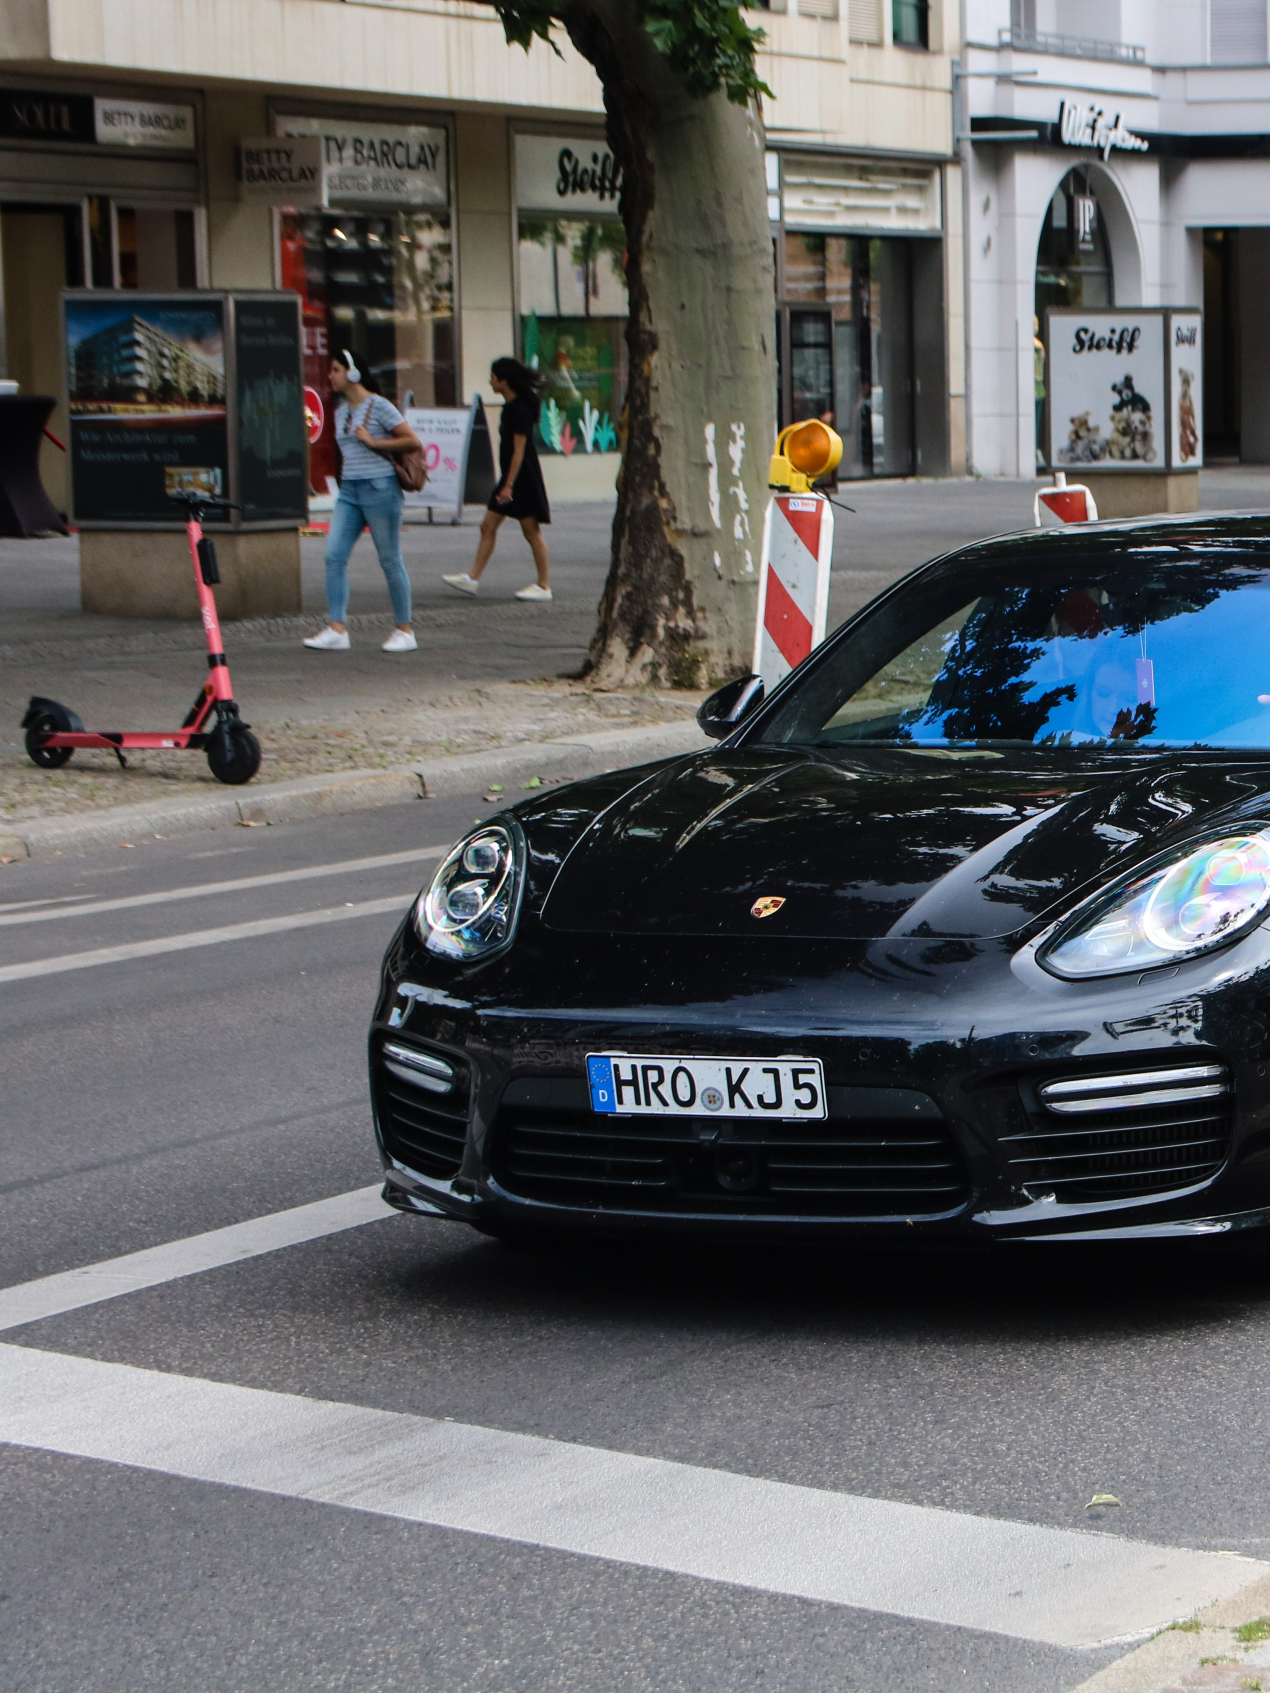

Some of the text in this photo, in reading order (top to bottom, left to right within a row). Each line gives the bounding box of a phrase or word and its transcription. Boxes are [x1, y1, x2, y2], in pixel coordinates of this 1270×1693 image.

[102, 109, 187, 132] BETTY BARCLAY
[245, 148, 294, 166] BETTY
[353, 138, 439, 171] BARCLAY
[246, 165, 318, 184] BARCLAY
[557, 146, 622, 202] Steiff
[1072, 325, 1141, 355] Steiff
[1175, 325, 1197, 347] Steiff
[599, 1089, 609, 1102] D
[613, 1063, 697, 1107] HRO
